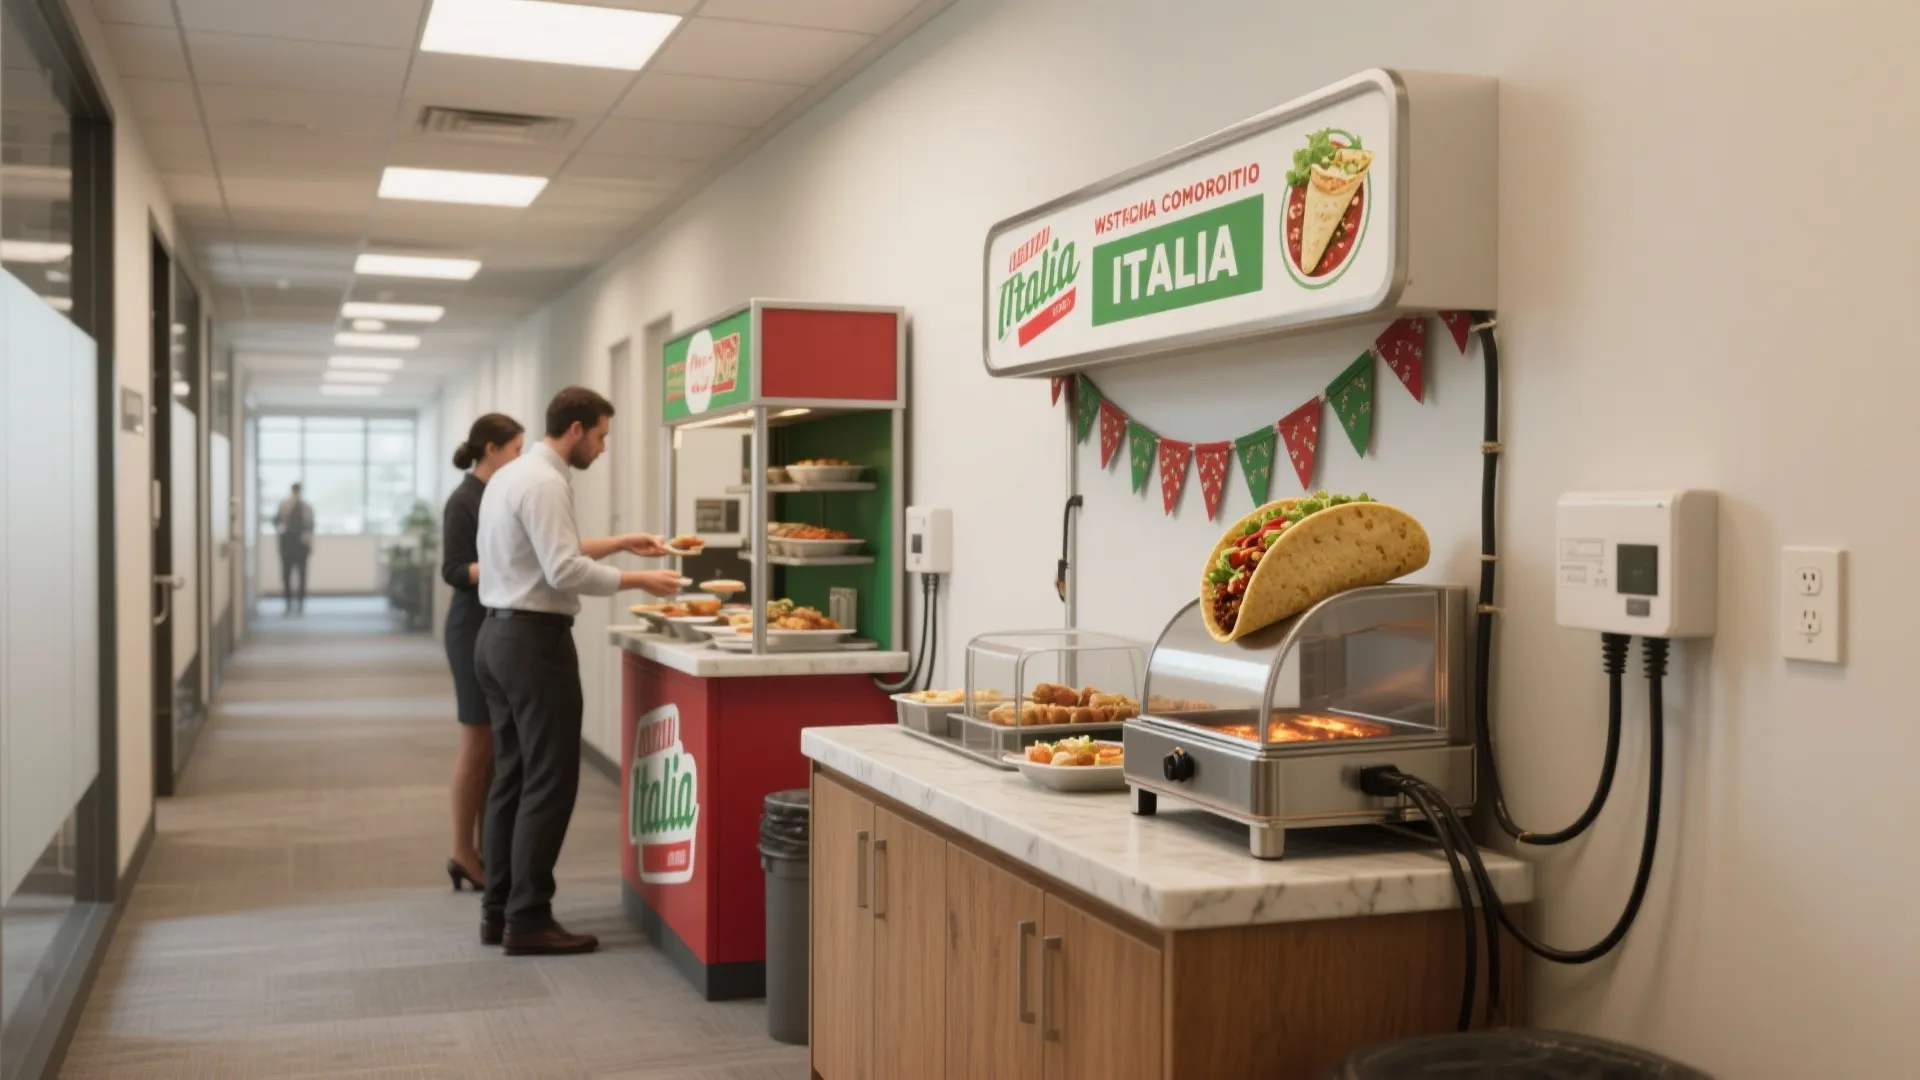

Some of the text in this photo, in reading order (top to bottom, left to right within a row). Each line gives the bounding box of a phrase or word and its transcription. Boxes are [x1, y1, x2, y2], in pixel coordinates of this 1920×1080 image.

[1161, 162, 1260, 213] COMOROITIO
[1113, 223, 1239, 305] ITALIA
[632, 753, 696, 837] Italia
